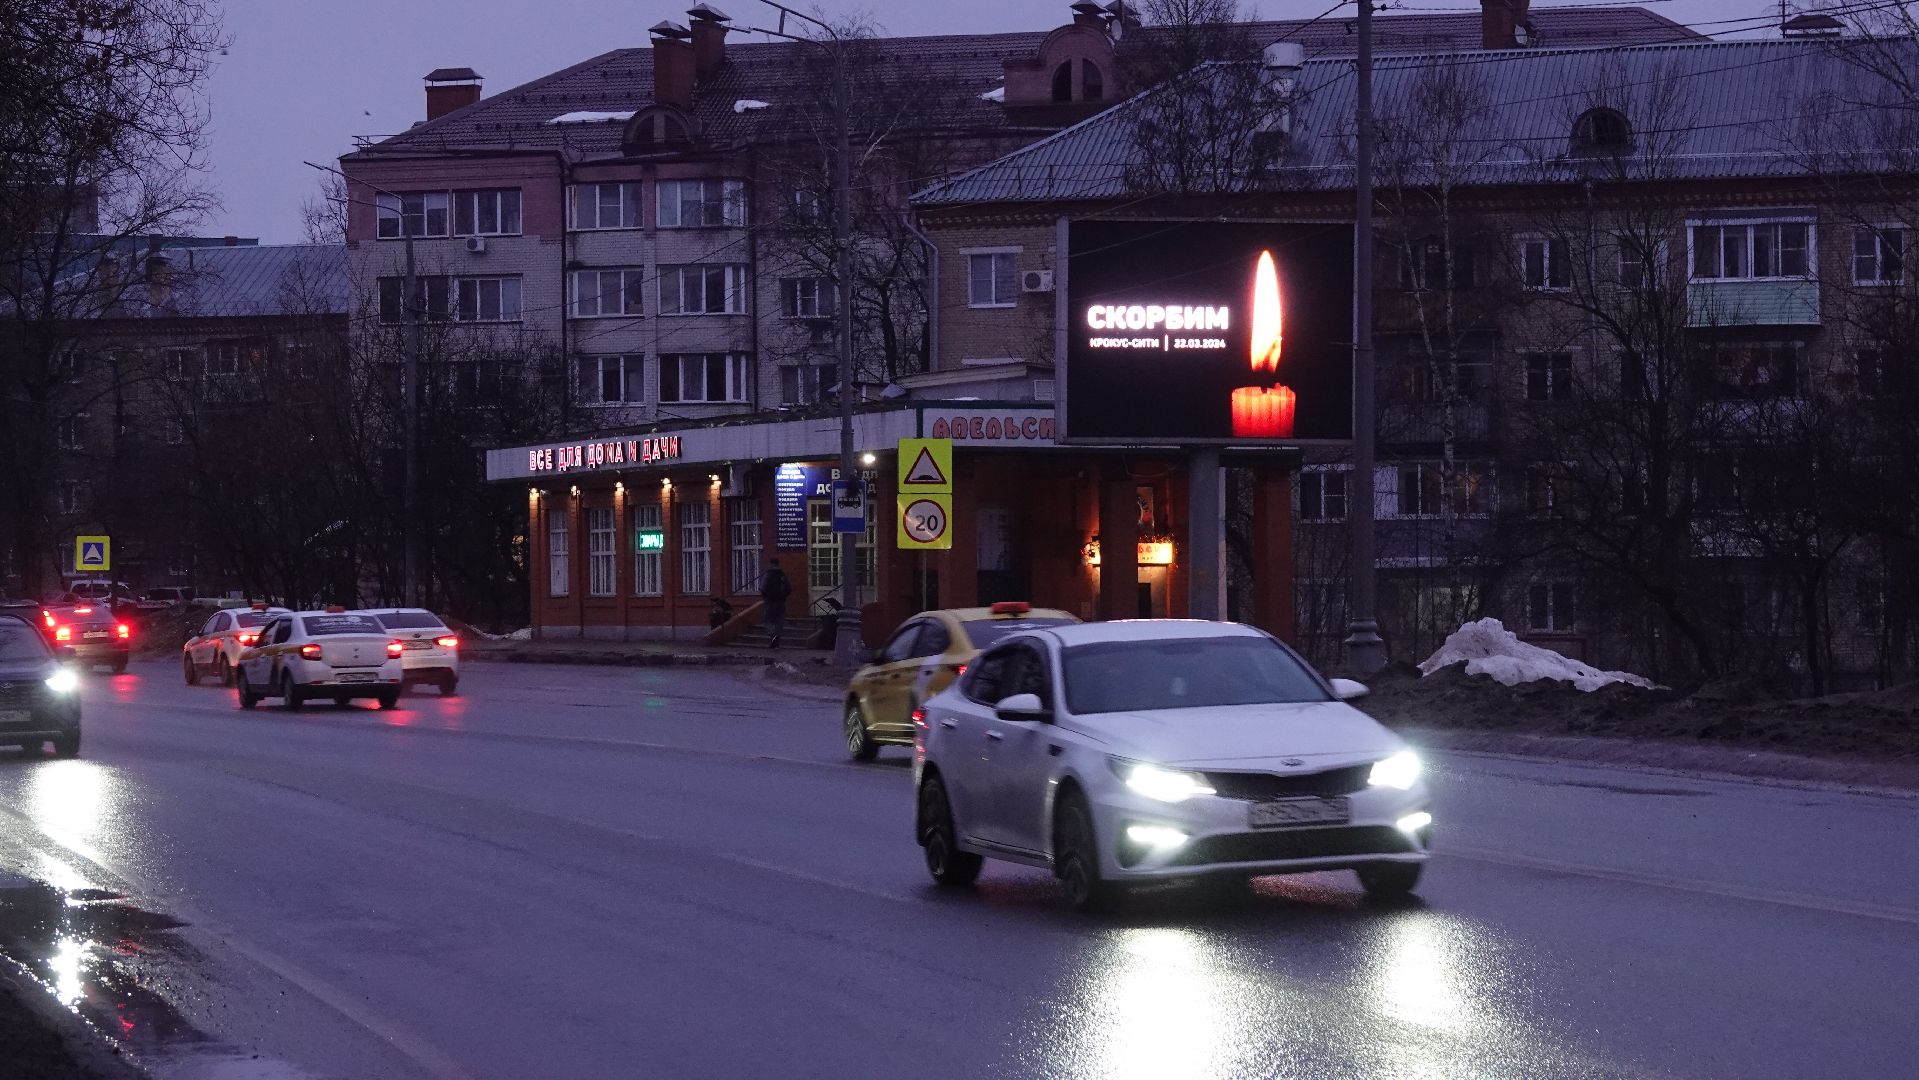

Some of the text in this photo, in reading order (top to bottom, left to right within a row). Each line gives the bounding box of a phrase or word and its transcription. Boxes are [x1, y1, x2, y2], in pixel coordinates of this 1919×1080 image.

[1087, 304, 1229, 330] СКОРБИМ
[1089, 337, 1226, 349] КРОКУС-СИТИ 22.03.2024
[932, 416, 1055, 440] АПЕЛЬСИ
[529, 449, 553, 471] ВСЕ
[558, 445, 582, 472] ДЛЯ
[628, 440, 637, 462] И
[642, 435, 679, 464] ДАЧИ
[915, 514, 939, 532] 20
